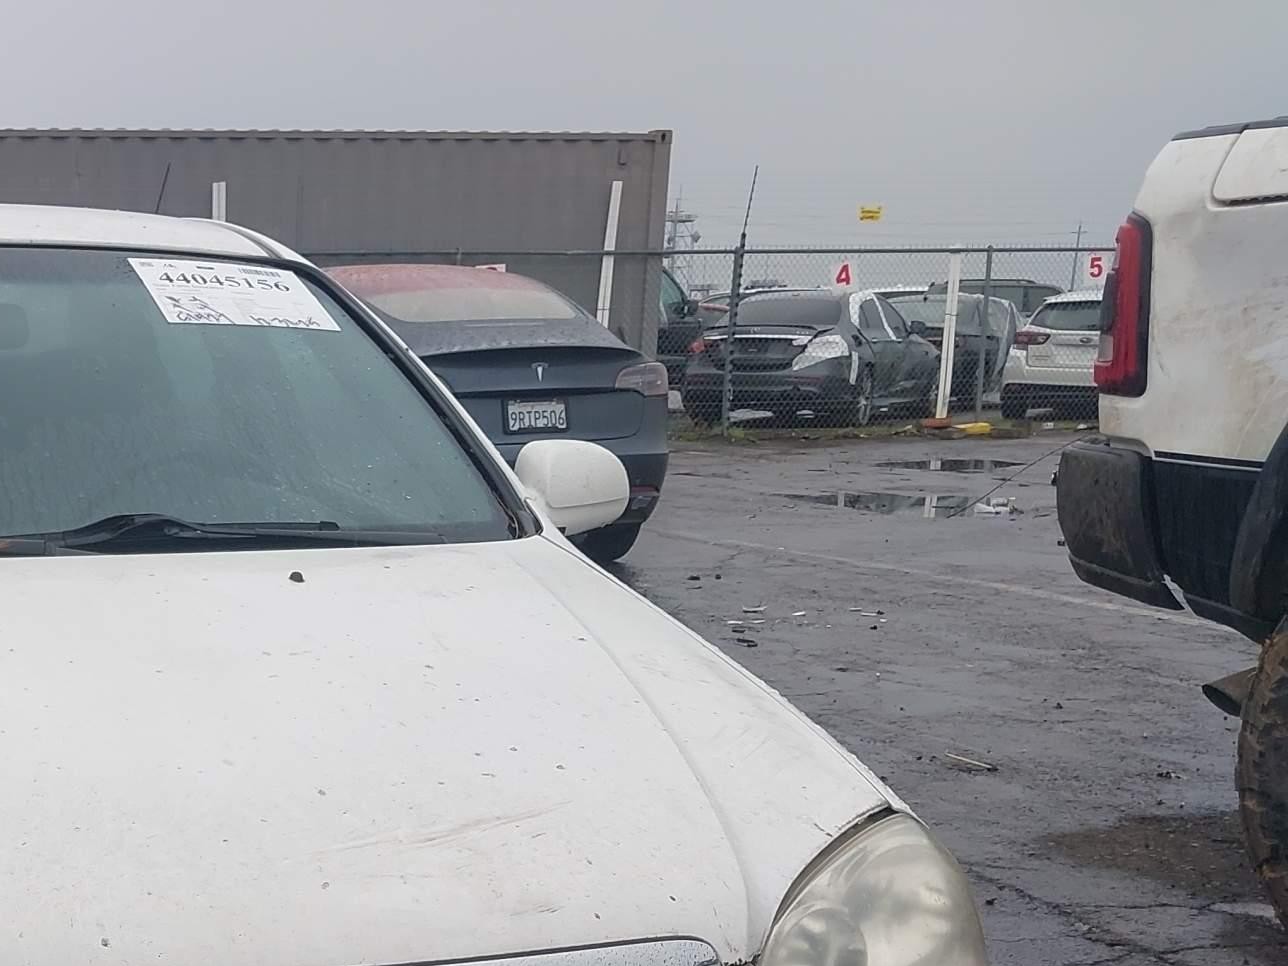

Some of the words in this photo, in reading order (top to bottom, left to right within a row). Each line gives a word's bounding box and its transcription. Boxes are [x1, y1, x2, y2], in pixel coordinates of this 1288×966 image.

[835, 263, 851, 287] 4
[1089, 256, 1103, 279] 5
[159, 272, 290, 292] 44045156
